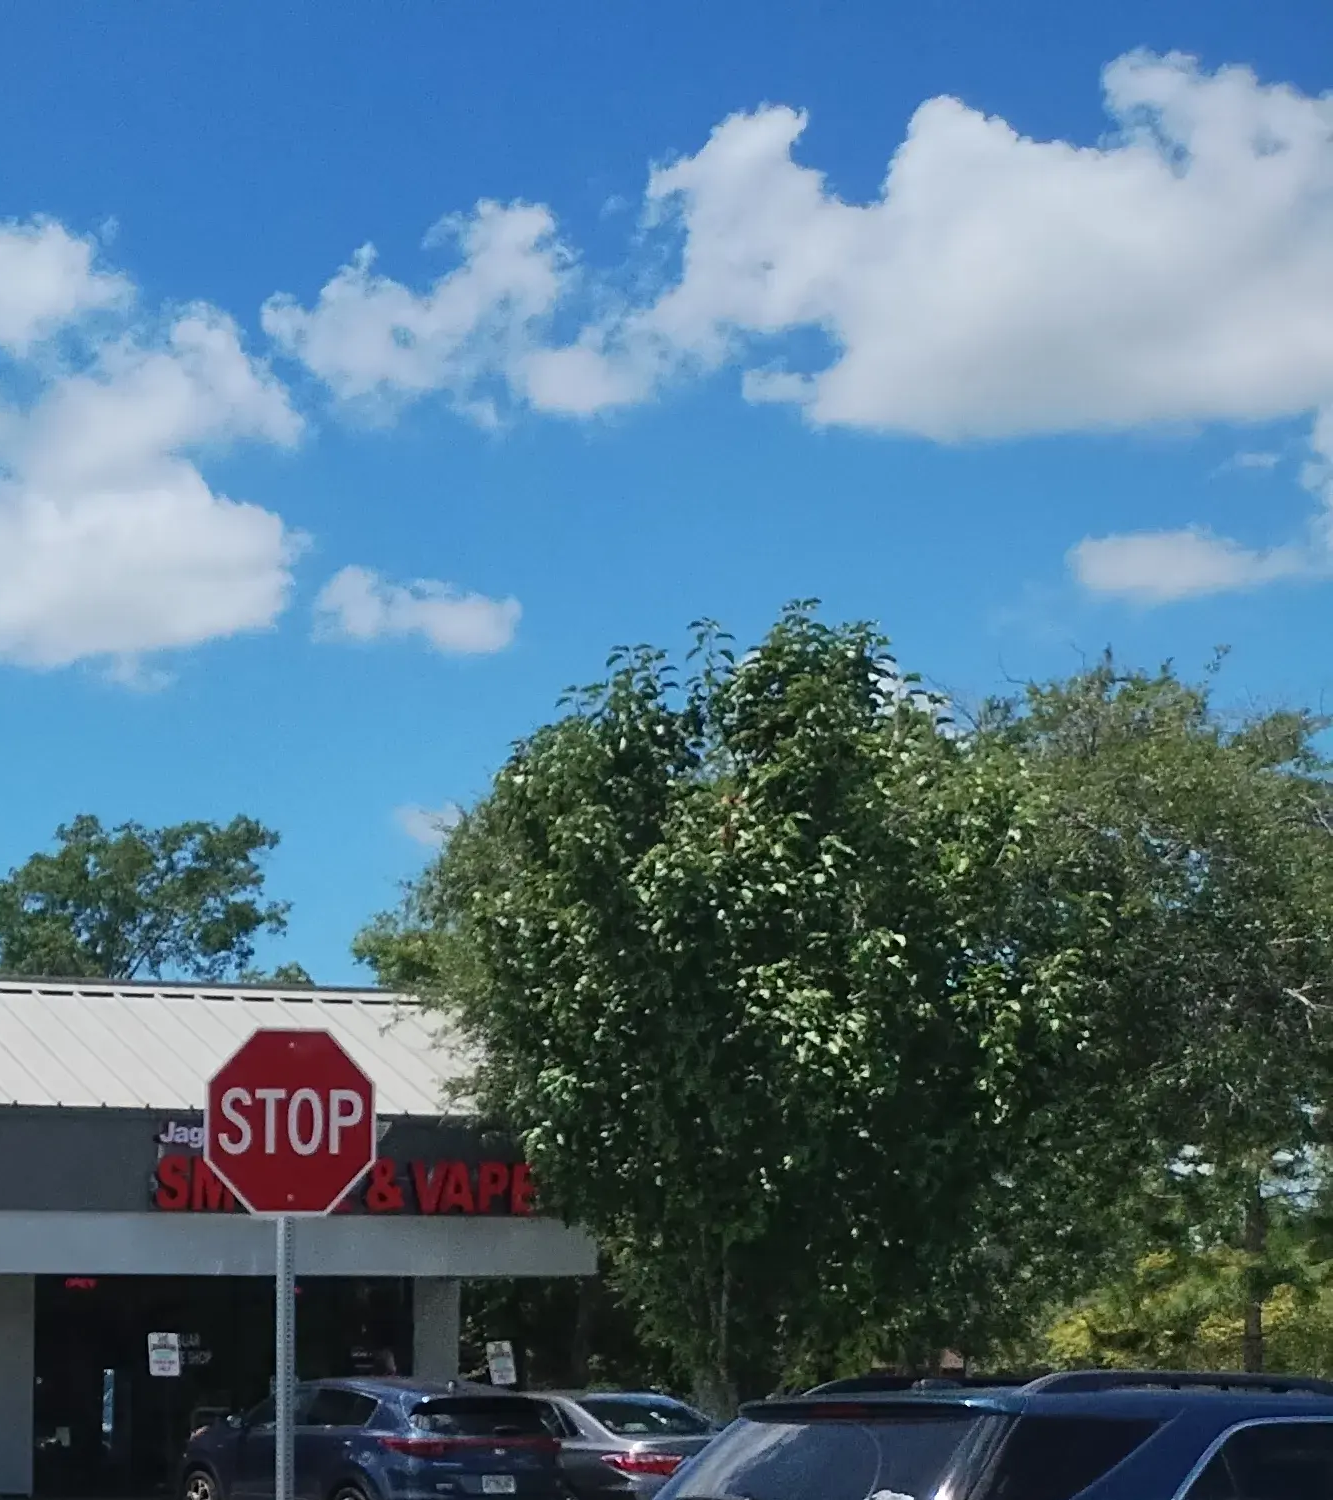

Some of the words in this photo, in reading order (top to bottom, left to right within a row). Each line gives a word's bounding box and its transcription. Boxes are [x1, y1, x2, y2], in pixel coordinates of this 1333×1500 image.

[217, 1087, 364, 1156] STOP
[366, 1158, 405, 1211] &
[410, 1160, 537, 1215] VAPE
